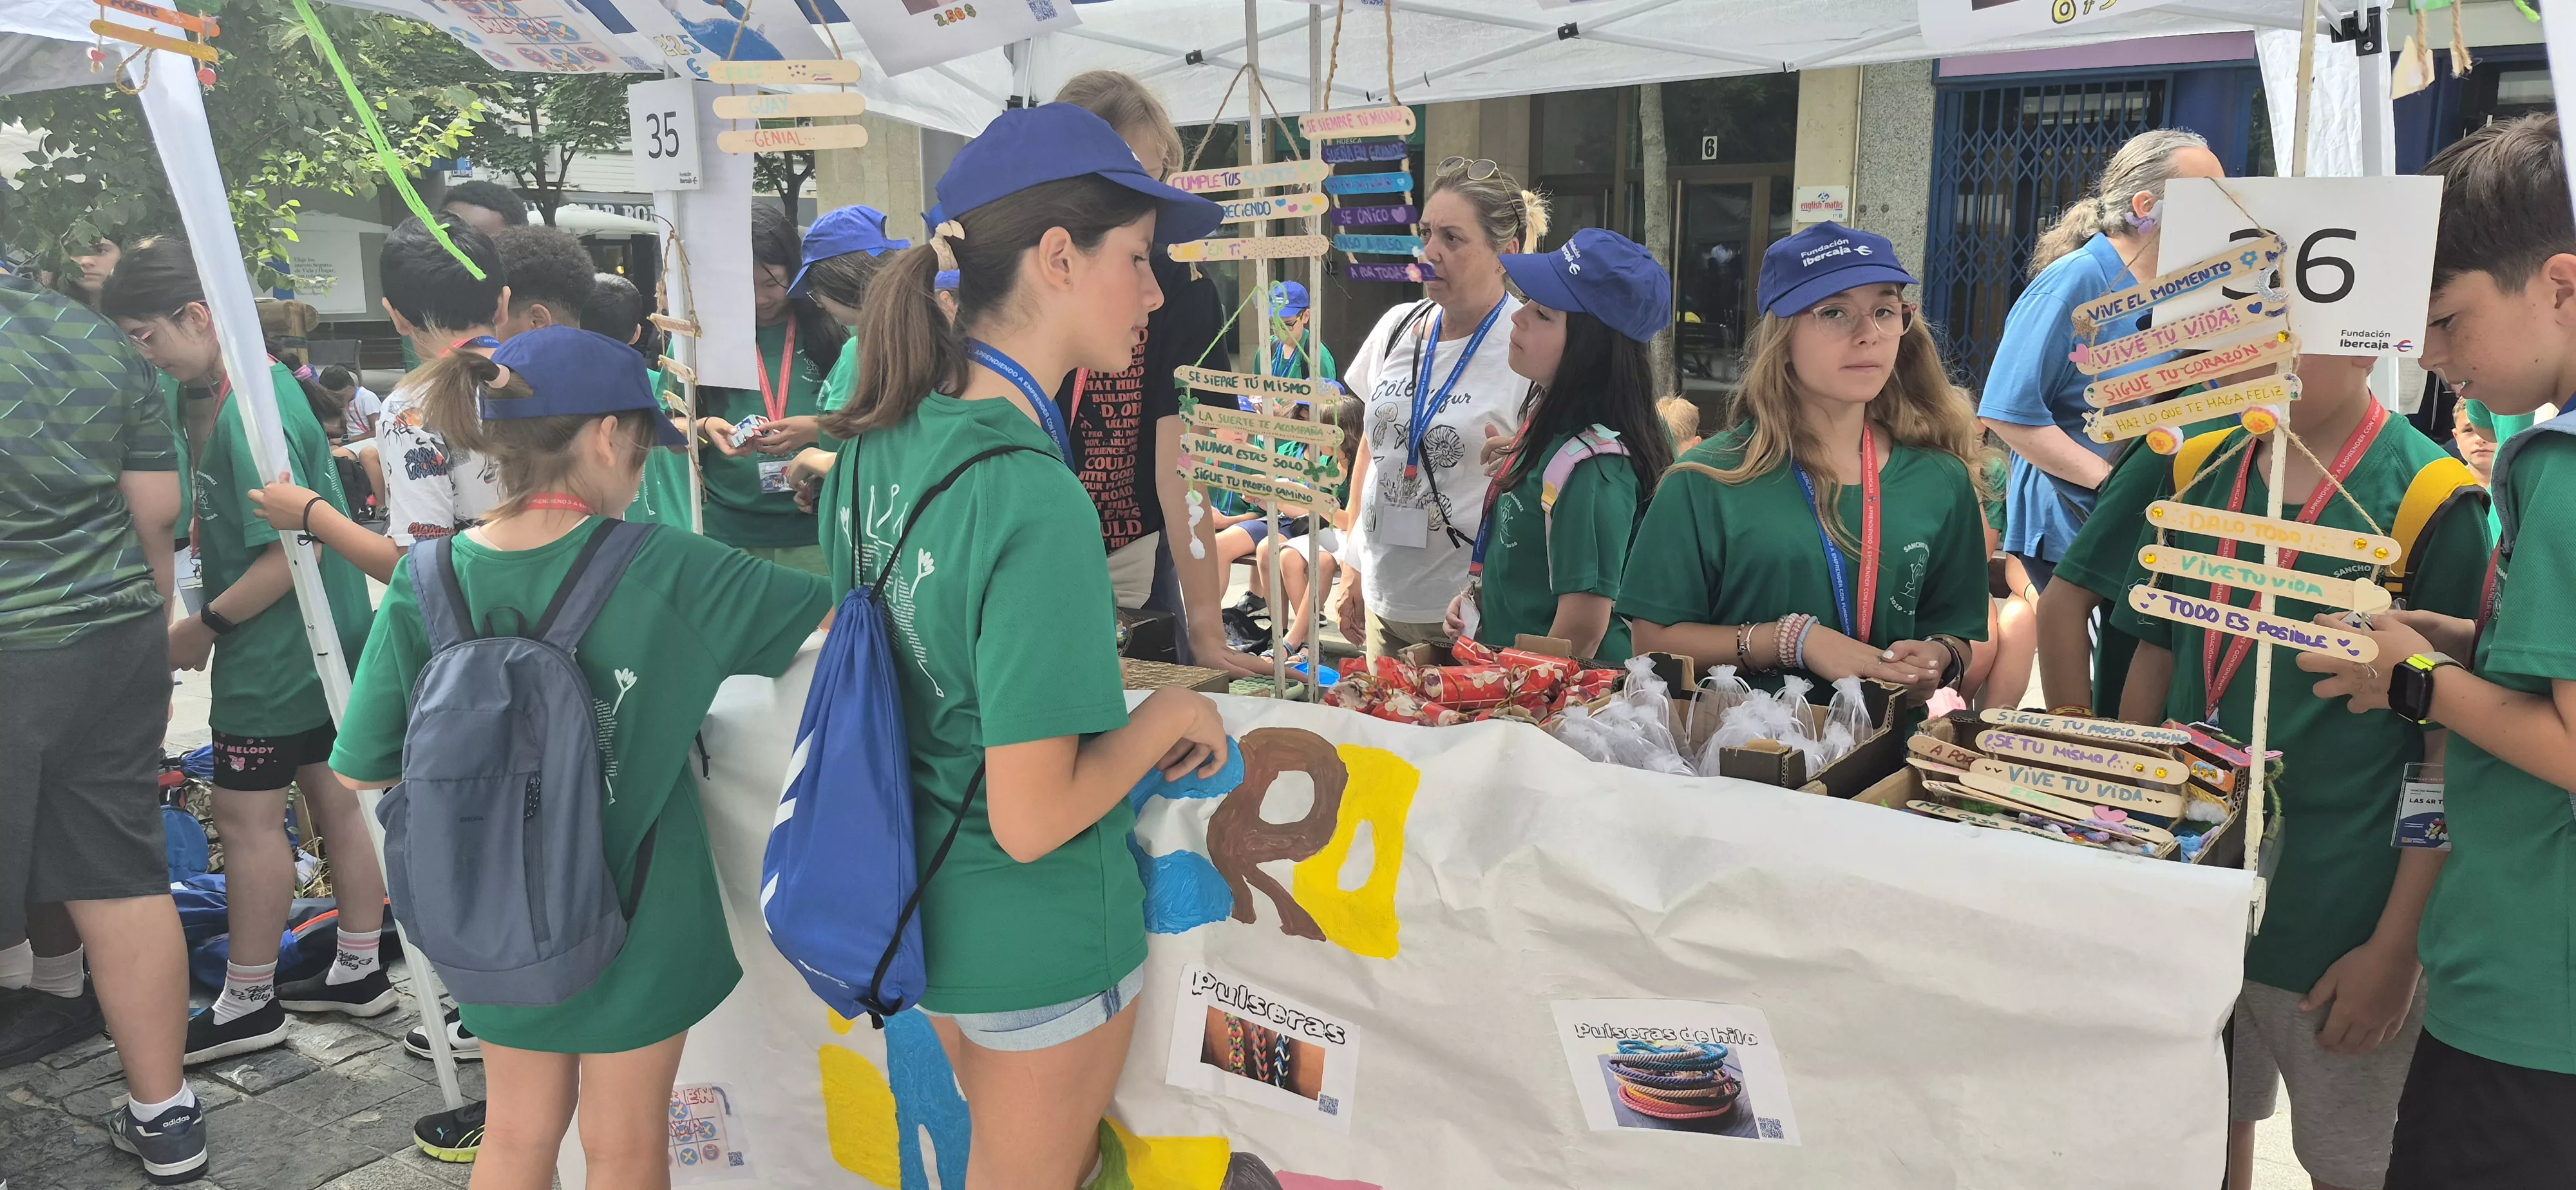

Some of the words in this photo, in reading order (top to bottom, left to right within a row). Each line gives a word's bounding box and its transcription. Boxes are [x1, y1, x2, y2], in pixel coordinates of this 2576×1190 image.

[749, 97, 789, 114] GUAY
[646, 111, 679, 159] 35
[1704, 138, 1716, 157] 6
[1172, 174, 1221, 191] CUMPLE
[1221, 172, 1241, 187] TUS
[1801, 201, 1822, 212] english
[1824, 200, 1843, 209] maths
[1341, 210, 1352, 224] SE
[1801, 239, 1850, 258] Fundación
[1803, 246, 1852, 267] Ibercaja
[2127, 293, 2146, 310] EL
[2150, 261, 2231, 301] MOMENTO
[2152, 328, 2176, 345] TU
[2340, 329, 2391, 338] Fundación
[2340, 339, 2389, 351] Ibercaja
[2156, 368, 2178, 383] TU
[2183, 344, 2259, 375] CORAZÓN
[1189, 371, 1201, 382] SE
[1244, 376, 1259, 389] TÚ
[974, 350, 1018, 377] APRENDIENDO
[1023, 381, 1050, 419] EMPRENDER
[1046, 415, 1055, 431] CON
[1092, 392, 1142, 403] BUILDING
[2116, 417, 2141, 432] HAZ
[2145, 412, 2157, 424] LO
[2161, 406, 2182, 420] QUE
[2186, 401, 2203, 412] TE
[2207, 392, 2244, 408] HAGA
[2246, 386, 2284, 401] FELIZ
[1198, 410, 1213, 422] LA
[1218, 413, 1254, 428] SUERTE
[1258, 419, 1271, 430] TE
[1274, 422, 1324, 437] ACOMPAÑA
[2339, 434, 2366, 469] EMPRENDER
[2363, 421, 2374, 434] CON
[1195, 440, 1234, 455] NUNCA
[1236, 449, 1268, 463] ESTAS
[1273, 458, 1303, 471] SOLO
[1226, 475, 1240, 487] TU
[1831, 552, 1842, 588] EMPRENDER
[2333, 564, 2371, 579] SANCHO
[1889, 596, 1903, 611] 2019
[2163, 594, 2219, 624] TODO
[2226, 612, 2249, 632] ES
[2063, 719, 2085, 730] TU
[227, 745, 274, 753] MELODY
[1929, 744, 1944, 756] A
[2019, 738, 2045, 754] TU
[2061, 775, 2090, 793] TU
[1192, 970, 1345, 1044] Pulseras
[1575, 1023, 1677, 1041] Pulseras
[1681, 1027, 1709, 1043] de
[1710, 1026, 1759, 1046] hilo
[163, 1115, 190, 1127] adidas
